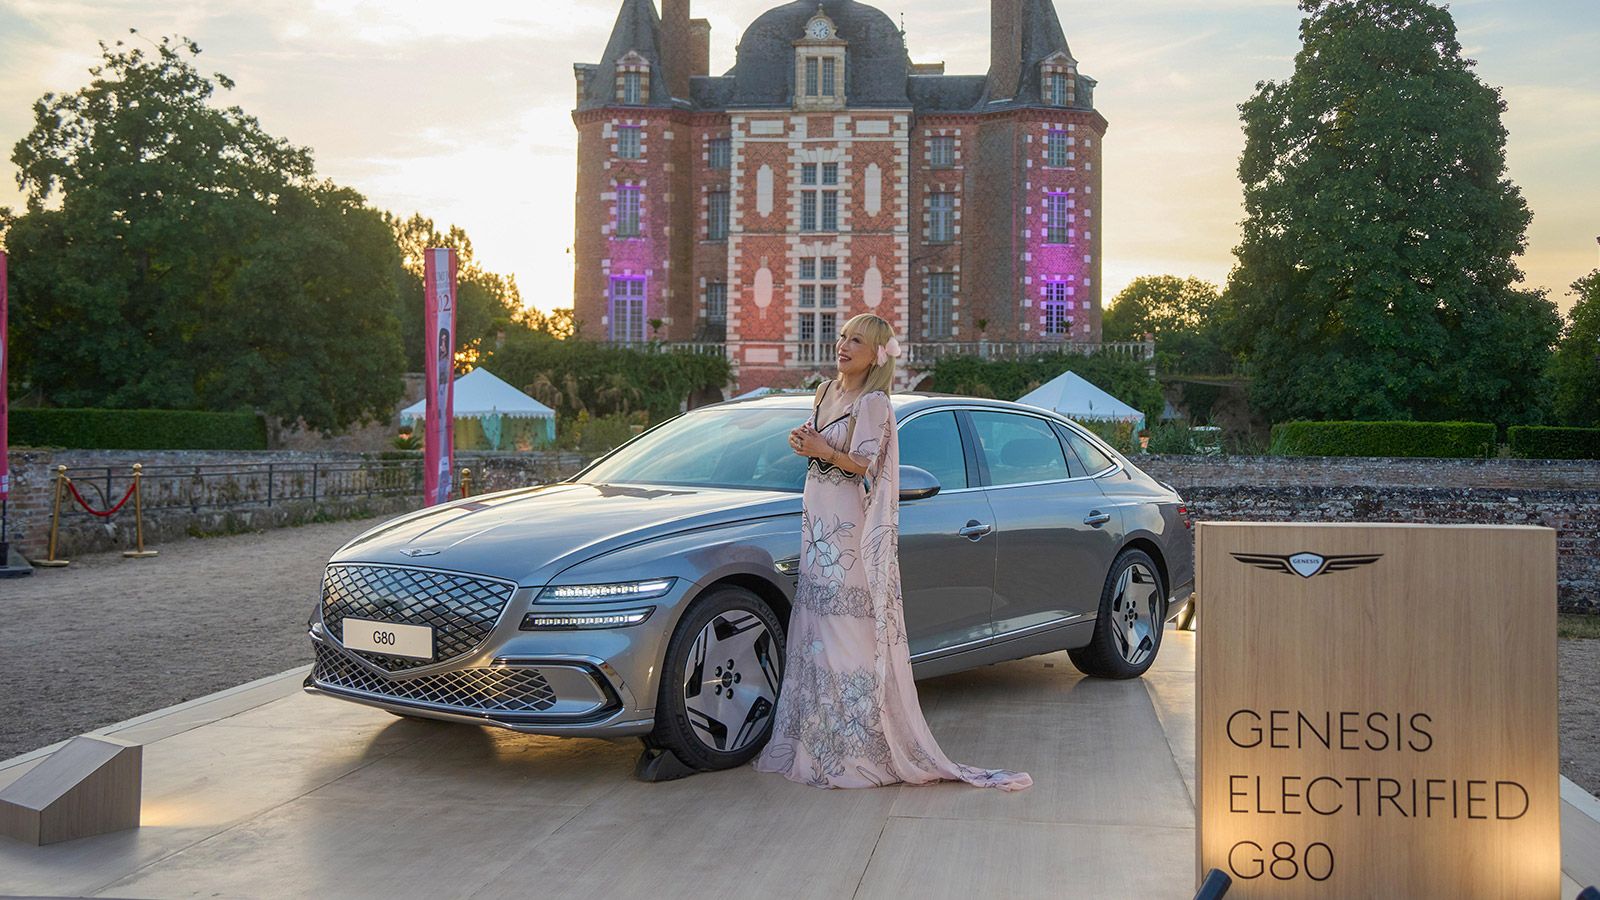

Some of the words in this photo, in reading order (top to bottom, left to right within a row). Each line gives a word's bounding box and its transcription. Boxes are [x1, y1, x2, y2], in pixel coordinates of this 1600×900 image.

[373, 630, 396, 645] G80
[1226, 709, 1433, 752] GENESIS
[1229, 775, 1529, 820] ELECTRIFIED
[1228, 840, 1334, 881] G80
